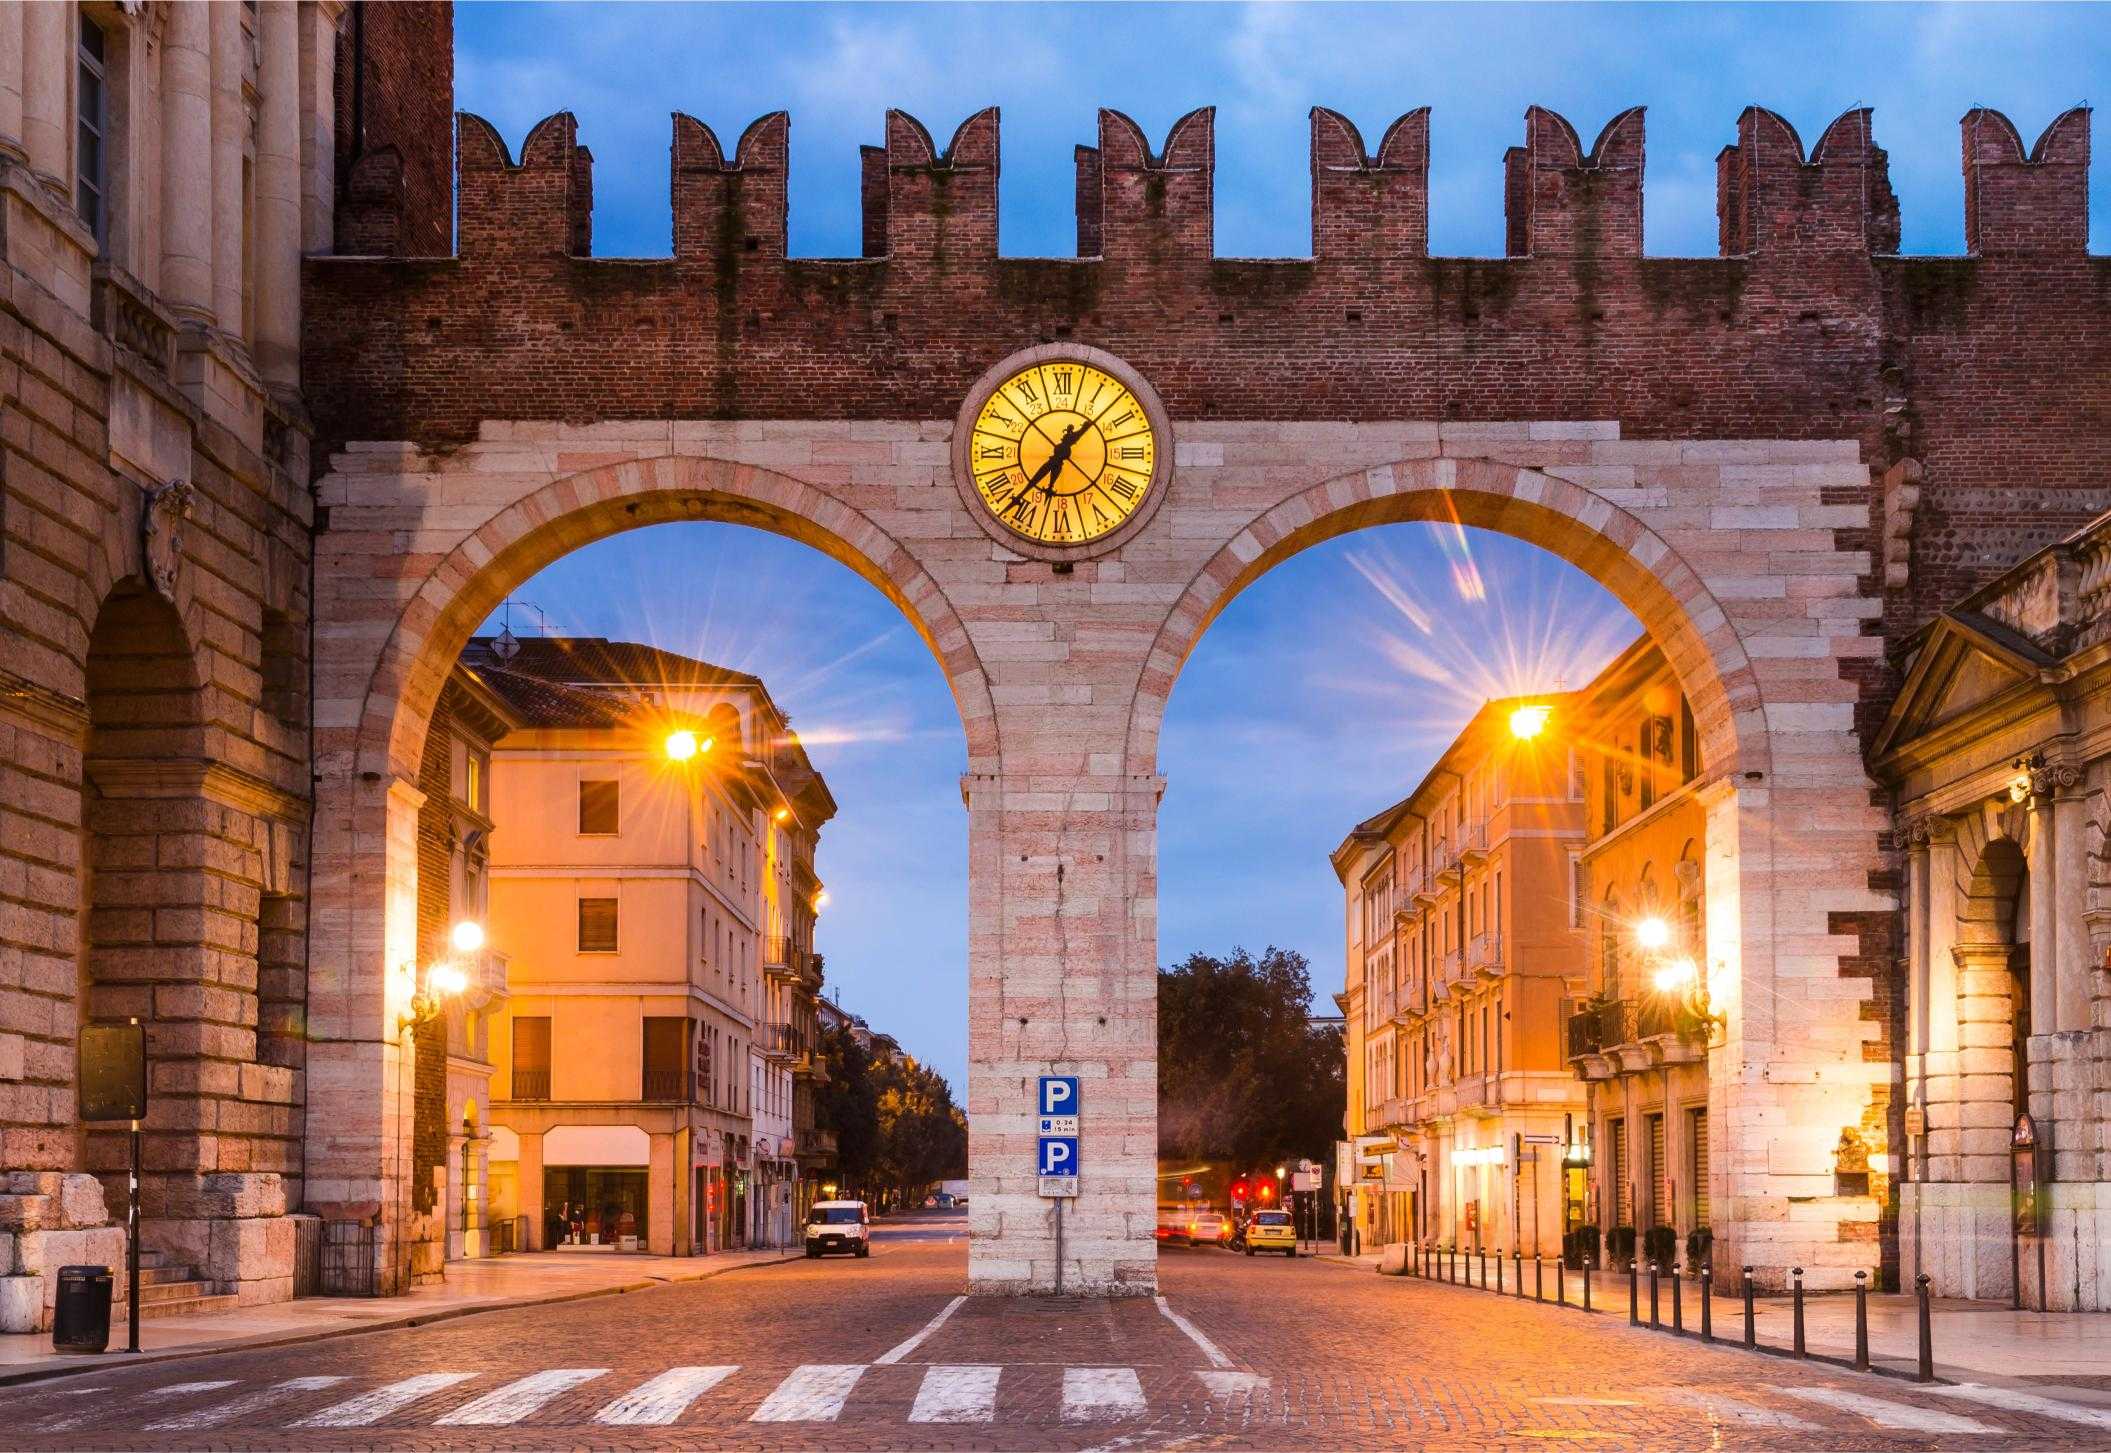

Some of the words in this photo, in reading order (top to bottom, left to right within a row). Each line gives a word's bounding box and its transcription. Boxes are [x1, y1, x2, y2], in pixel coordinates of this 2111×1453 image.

[1053, 372, 1072, 395] XII
[1016, 380, 1039, 405] XI
[1089, 382, 1105, 404] I
[1030, 403, 1043, 415] 23
[1056, 397, 1067, 408] 24
[1084, 403, 1094, 415] 13
[989, 408, 1013, 428] X
[1112, 410, 1135, 428] II
[1011, 421, 1023, 432] 22
[1103, 421, 1113, 433] 14
[981, 445, 1004, 459] IX
[1006, 446, 1016, 458] 21
[1110, 448, 1120, 460] 15
[1121, 447, 1144, 460] III
[1011, 473, 1023, 486] 20
[1104, 473, 1113, 485] 16
[1111, 475, 1138, 501] IIII
[1057, 497, 1067, 510] 18
[1083, 492, 1093, 504] 17
[1092, 503, 1111, 526] V
[1053, 510, 1072, 534] VI
[1046, 1080, 1071, 1112] P
[1047, 1142, 1070, 1171] P
